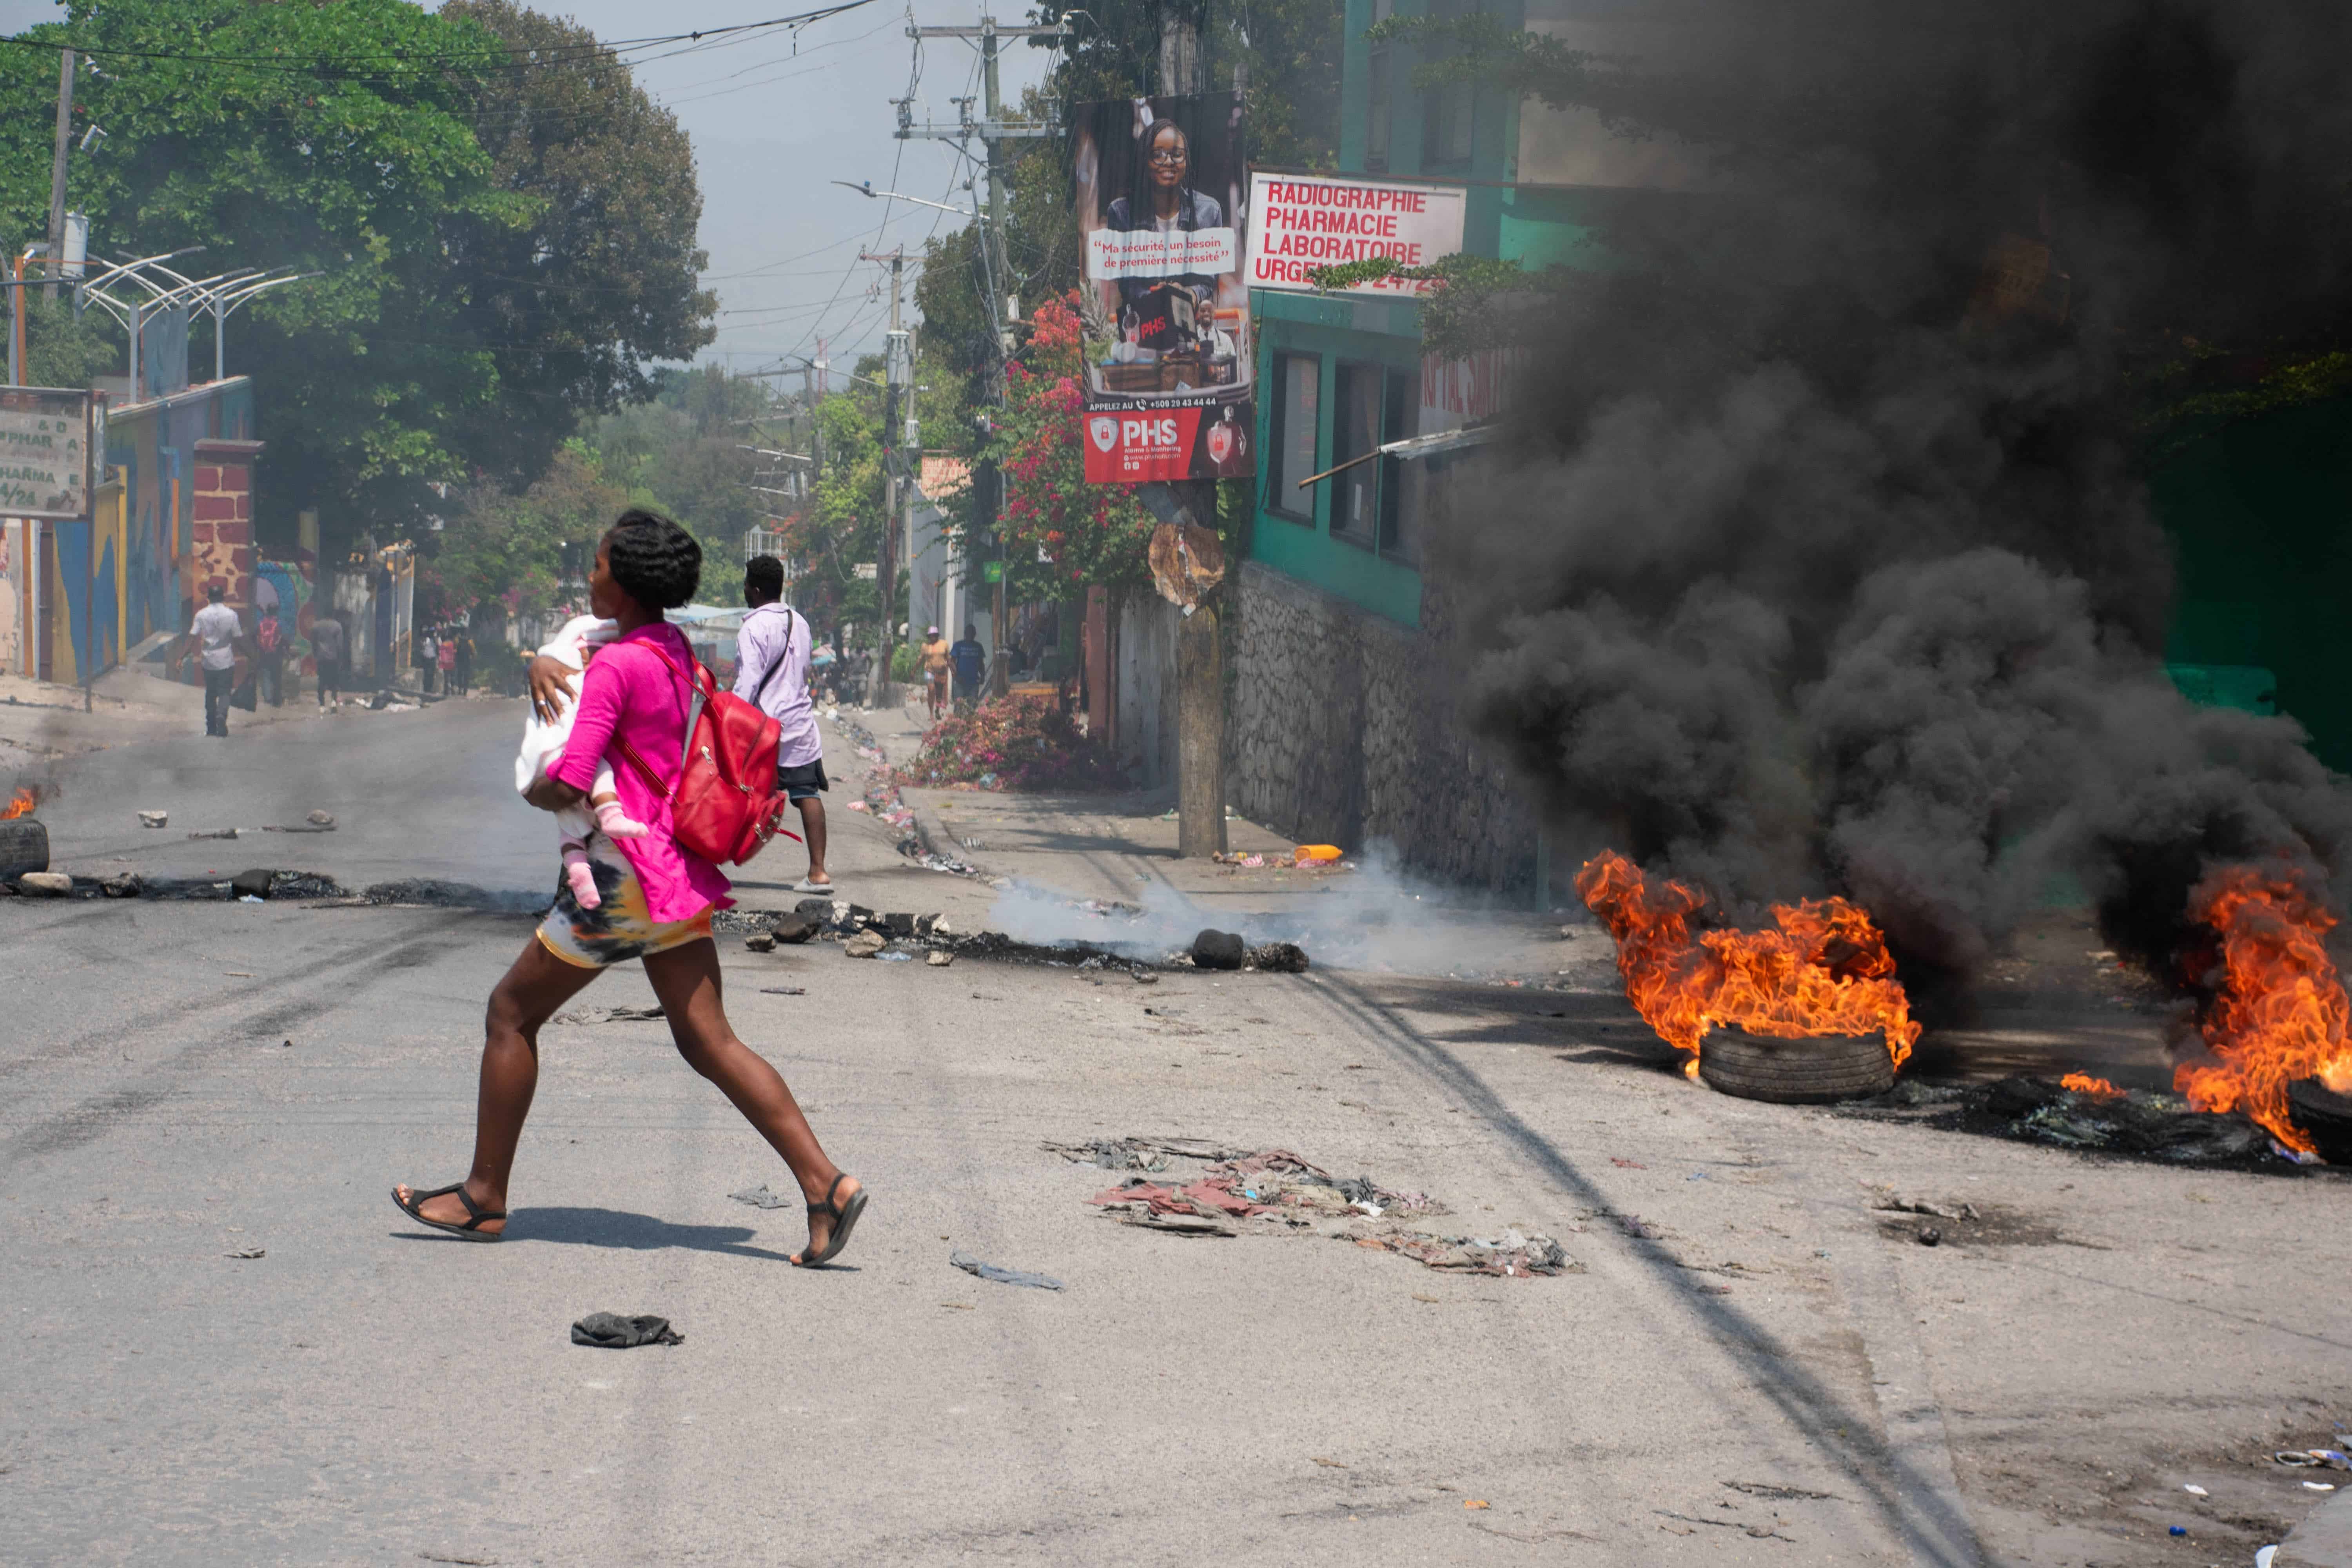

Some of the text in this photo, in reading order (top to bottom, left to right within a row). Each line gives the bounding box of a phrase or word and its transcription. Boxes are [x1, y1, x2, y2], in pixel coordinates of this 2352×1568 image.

[1268, 181, 1426, 213] RADIOGRAPHIE
[1266, 207, 1397, 237] PHARMACIE
[1094, 240, 1119, 254] “Ma
[1122, 240, 1167, 253] sécurité,
[1186, 236, 1221, 249] besoin
[1264, 233, 1421, 265] LABORATOIRE
[1104, 250, 1229, 270] de première nécessité”
[1256, 258, 1360, 286] URGE
[1141, 316, 1166, 339] PHS
[1089, 402, 1120, 411] APPELEZ
[1122, 402, 1133, 410] AU
[1171, 399, 1180, 407] 29
[56, 421, 67, 433] D
[1123, 419, 1177, 446] PHS
[67, 439, 77, 450] A
[69, 474, 78, 485] E
